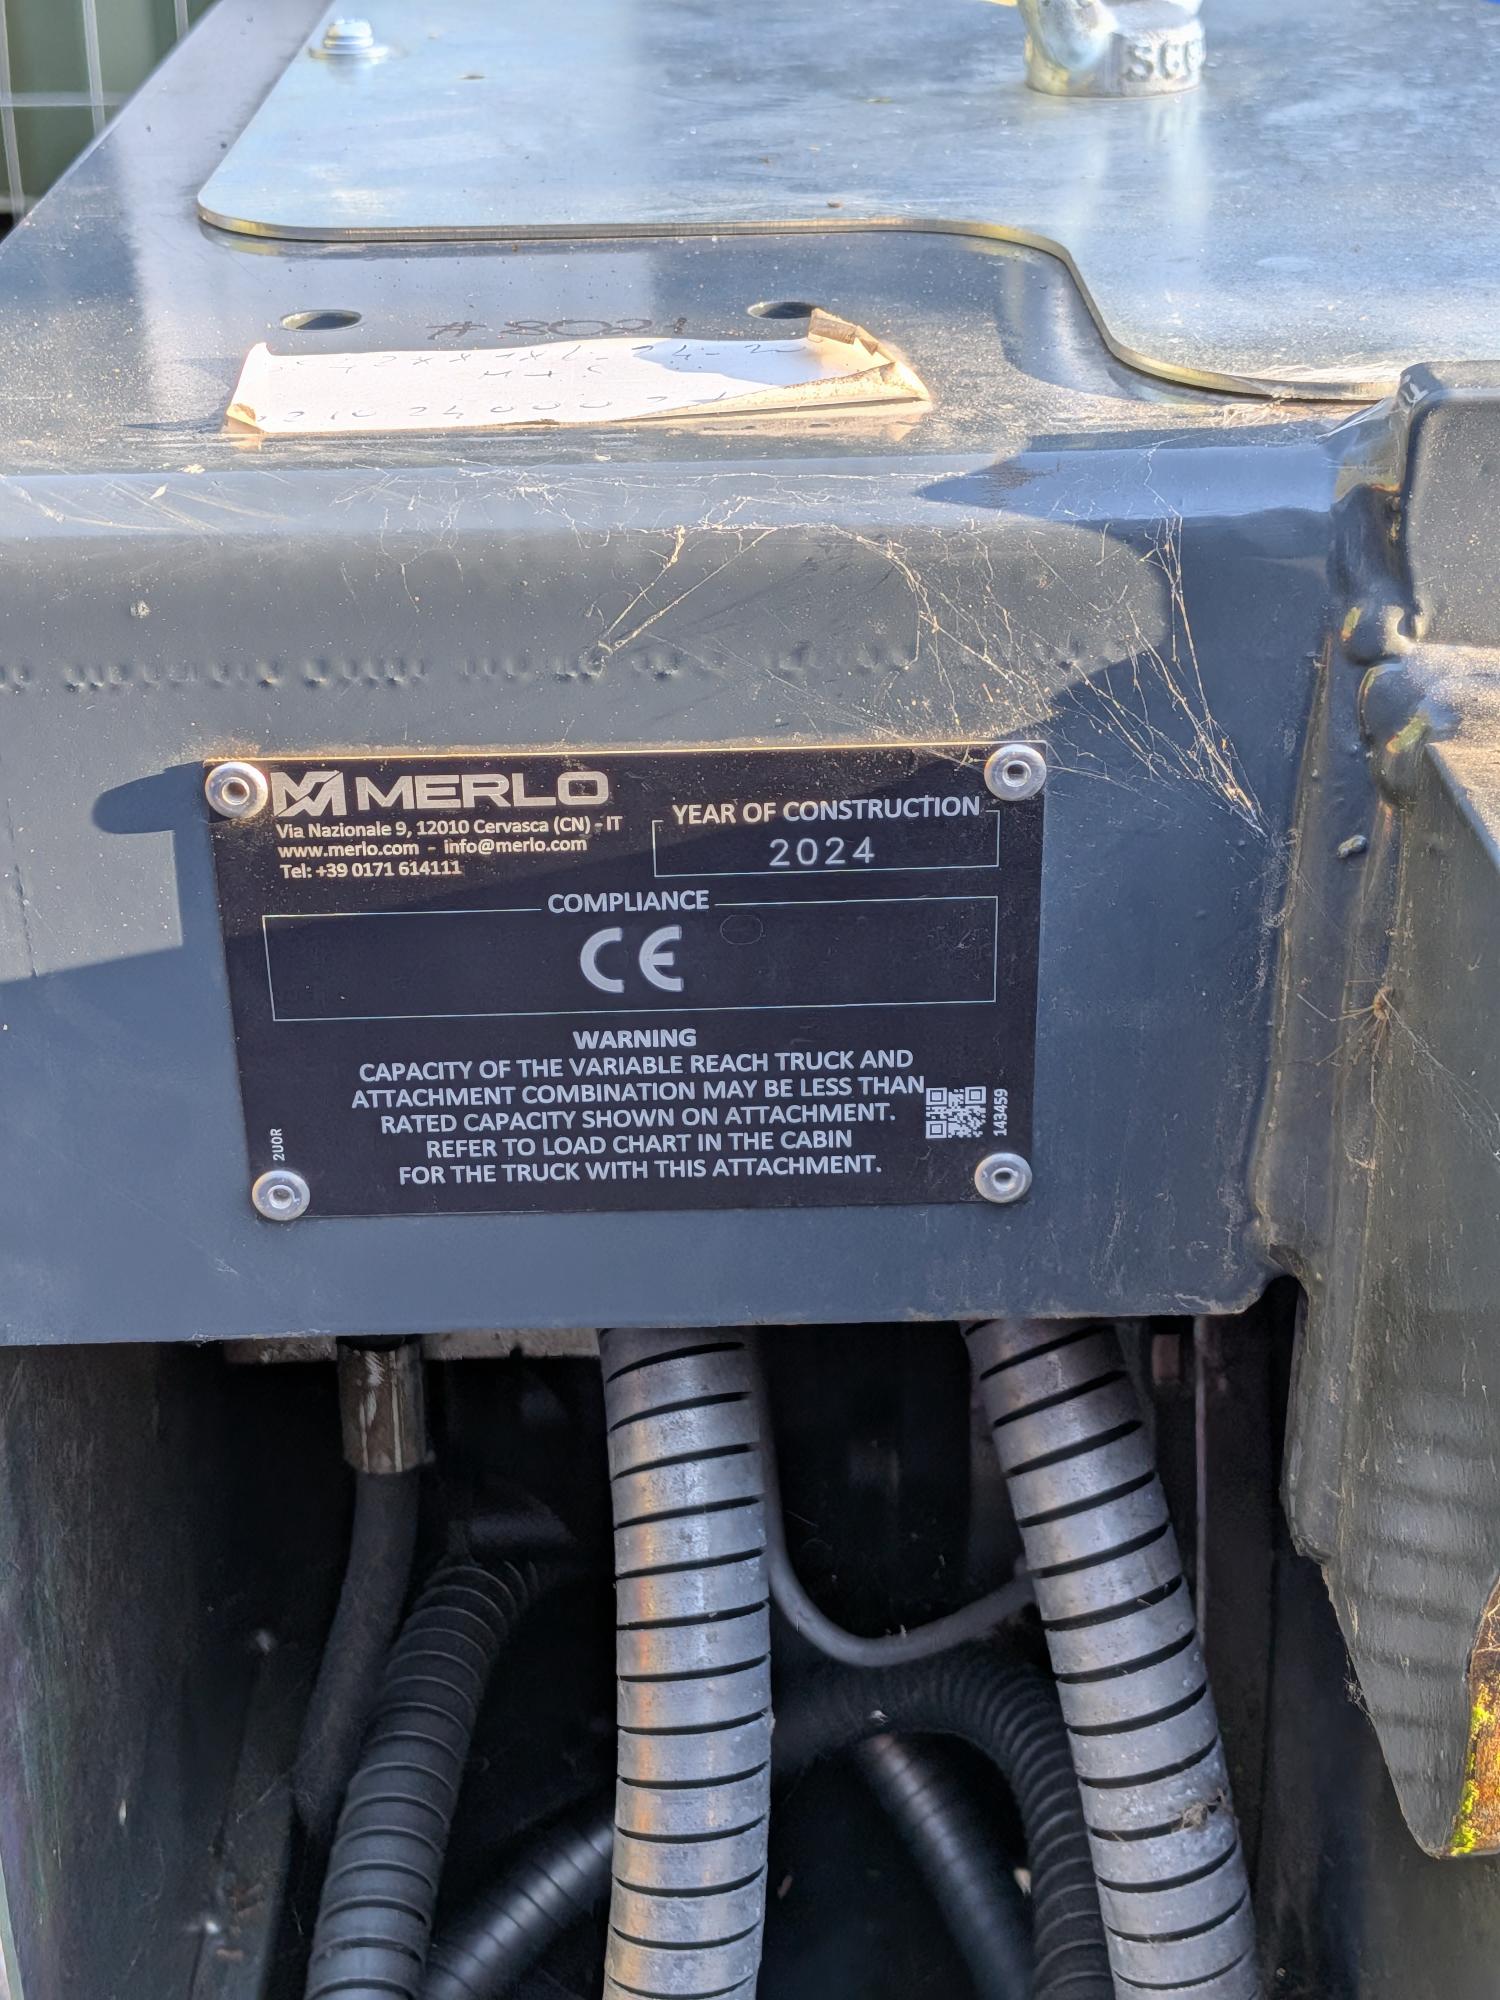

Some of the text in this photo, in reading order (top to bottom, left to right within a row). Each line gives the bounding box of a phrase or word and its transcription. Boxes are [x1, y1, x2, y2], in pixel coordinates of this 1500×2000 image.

[355, 771, 609, 811] MERLO
[672, 795, 980, 825] YEAR OF CONSTRUCTION
[277, 824, 304, 839] Via
[308, 821, 391, 838] Nazionale
[396, 821, 413, 839] 9,
[417, 819, 469, 837] 12010
[474, 818, 548, 835] Cervasca
[554, 815, 591, 835] (CN)
[606, 816, 622, 832] IT
[278, 840, 419, 857] www.merlo.com
[444, 837, 587, 855] info@merlo.com
[769, 836, 875, 867] 2024
[280, 860, 462, 879] Tel: +39 0171 614111
[548, 889, 709, 913] COMPLIANCE
[580, 924, 684, 993] CE
[572, 1028, 696, 1050] WARNING
[359, 1049, 913, 1082] CAPACITY OF THE VARIABLE REACH TRUCK AND
[351, 1075, 925, 1108] ATTACHMENT COMBINATION MAY BE LESS THAN
[381, 1102, 896, 1134] RATED CAPACITY SHOWN ON ATTACHMENT.
[993, 1088, 1009, 1137] 143459
[426, 1129, 852, 1159] REFER TO LOAD CHART IN THE CABIN
[399, 1154, 882, 1185] FOR THE TRUCK WITH THIS ATTACHMENT.
